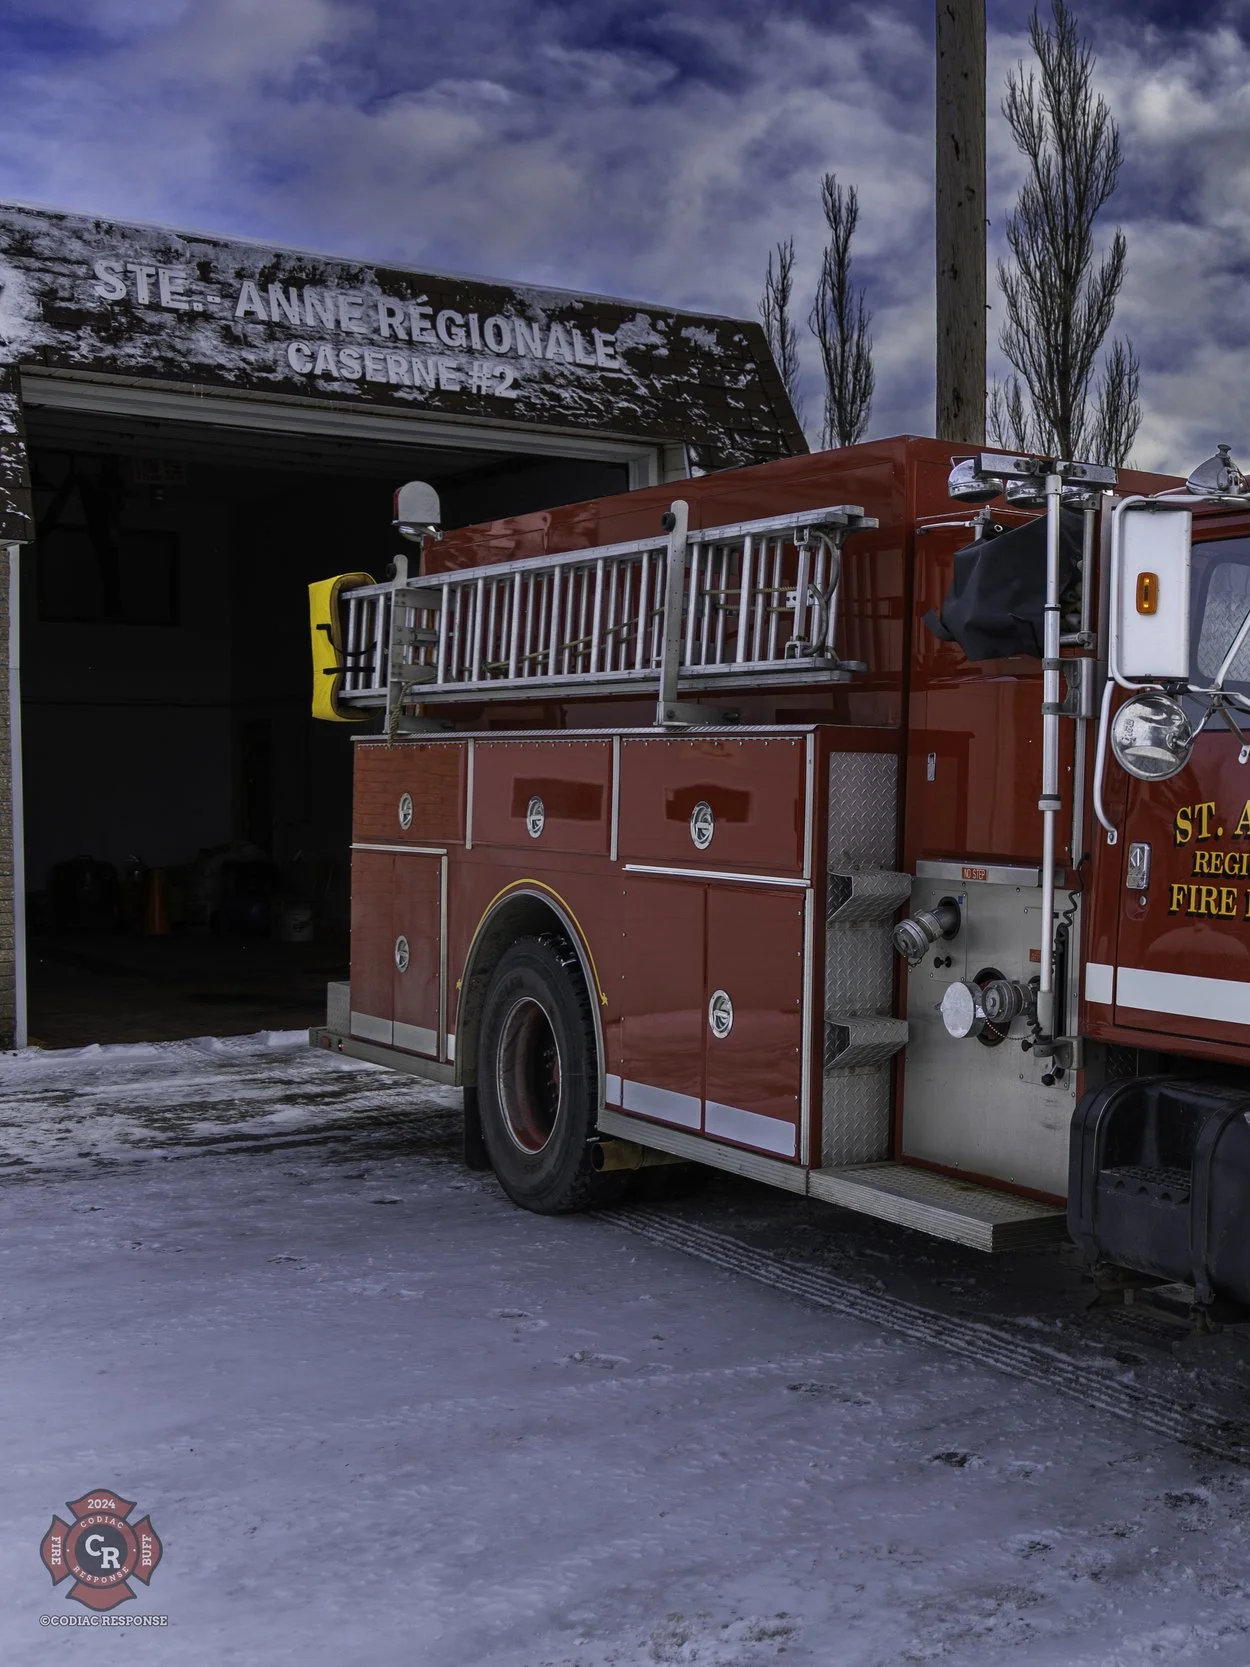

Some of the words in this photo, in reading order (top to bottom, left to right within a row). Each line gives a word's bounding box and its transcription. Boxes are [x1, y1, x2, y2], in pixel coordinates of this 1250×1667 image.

[377, 295, 620, 370] RÉGIONALE
[287, 342, 460, 392] CASERNE
[468, 359, 518, 399] #2
[1174, 801, 1224, 845] ST.
[963, 868, 972, 879] NO
[972, 868, 986, 879] STEP
[1169, 883, 1238, 916] FIRE
